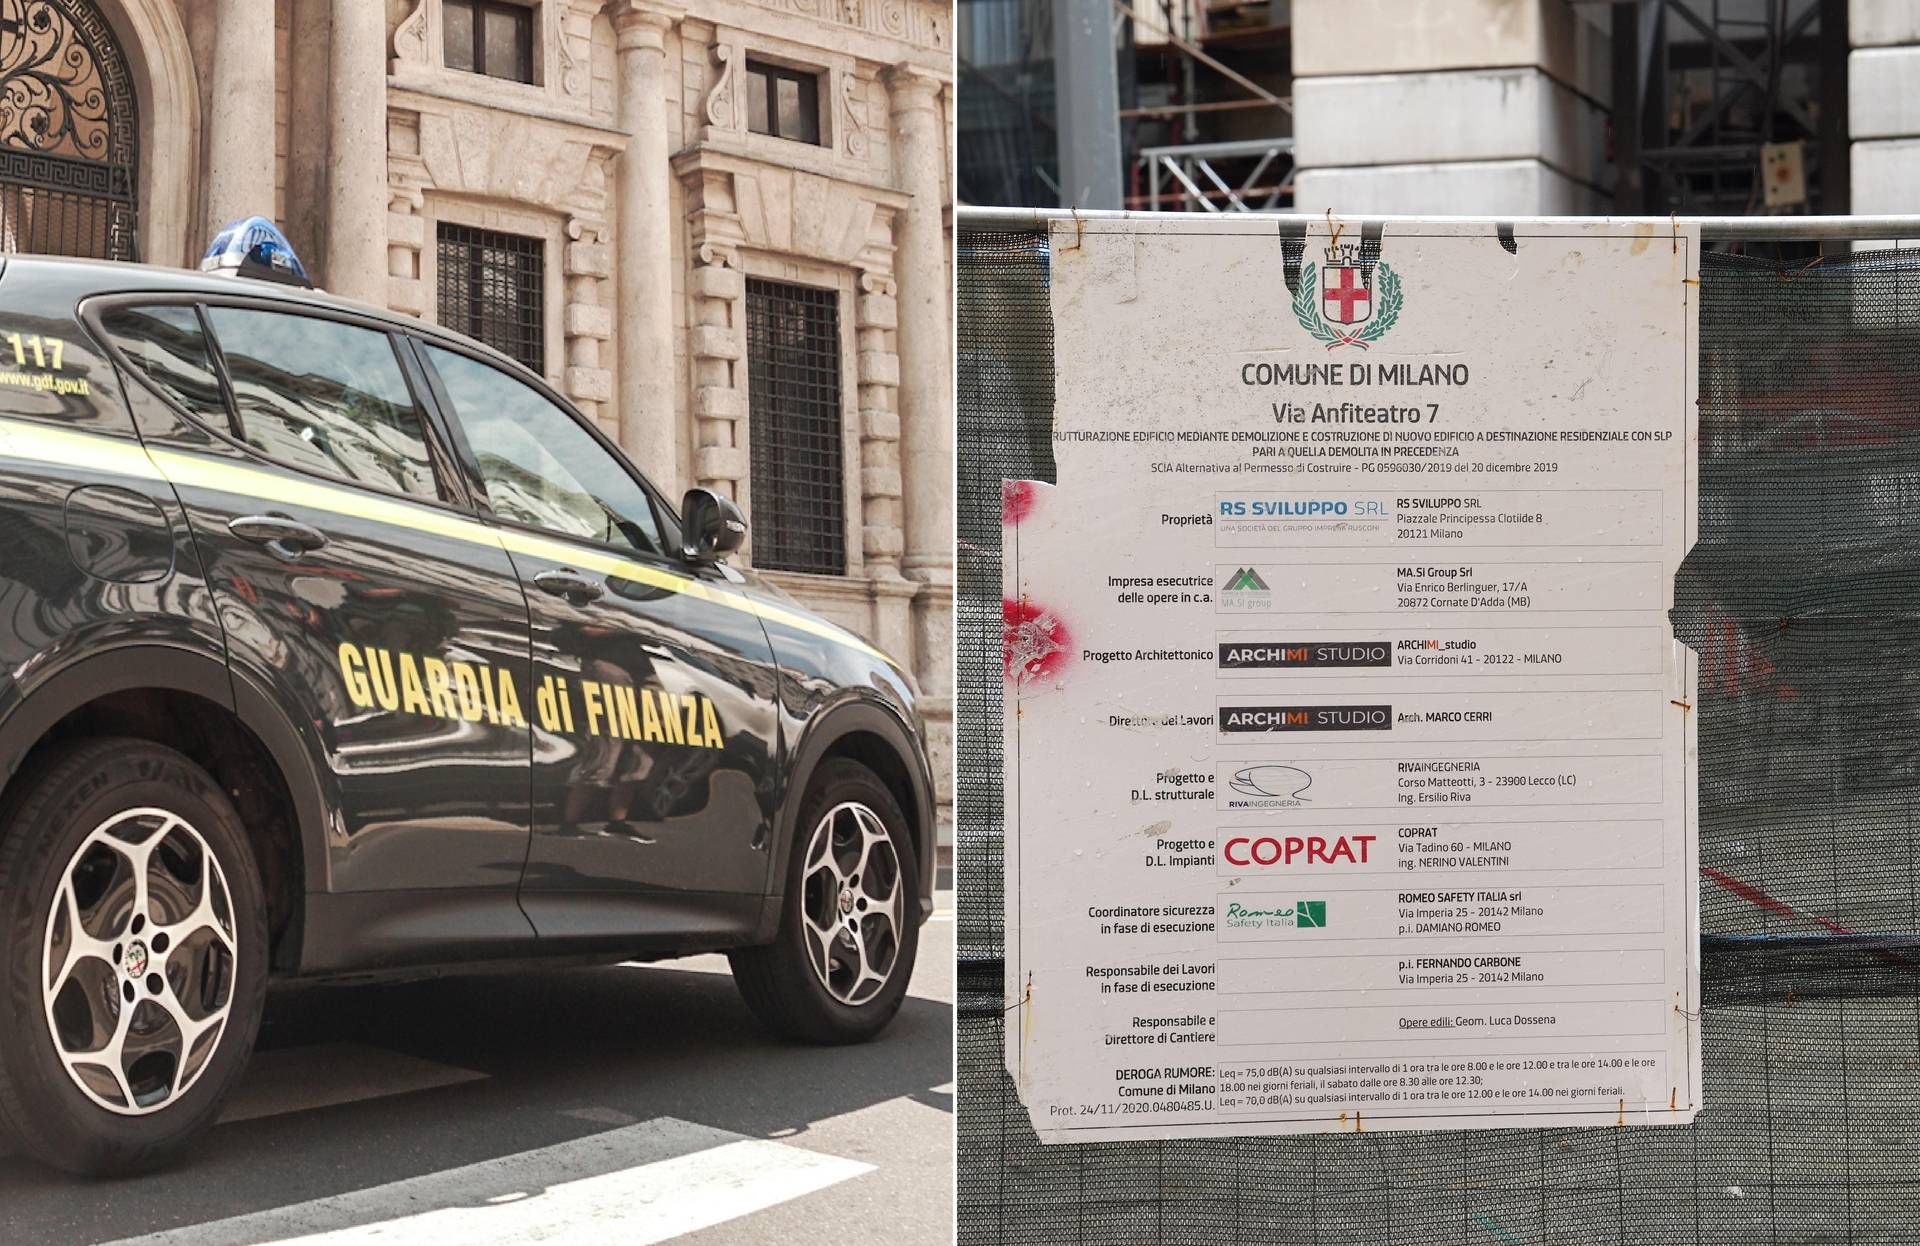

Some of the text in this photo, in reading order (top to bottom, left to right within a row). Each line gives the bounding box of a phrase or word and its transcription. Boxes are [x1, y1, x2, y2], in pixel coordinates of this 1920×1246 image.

[7, 333, 63, 370] 117
[1241, 362, 1469, 386] COMUNE DI MILANO
[1271, 401, 1439, 423] Via Anfiteatro 7
[1132, 431, 1175, 442] EDIFICIO
[1176, 430, 1229, 442] MEDIANTE
[1230, 430, 1301, 442] DEMOLIZIONE
[1309, 430, 1381, 442] COSTRUZIONE
[1394, 431, 1432, 442] NUOVO
[1433, 431, 1475, 442] EDIFICIO
[1485, 430, 1558, 442] DESTINAZIONE
[1559, 430, 1629, 442] RESIDENZIALE
[1251, 445, 1276, 457] PARI
[1327, 445, 1379, 457] DEMOLITA
[1393, 445, 1459, 457] PRECEDENZA
[1150, 461, 1558, 473] SCIA Alternativa Permesso Costruire 0596030/2019 dicembre 2019
[1219, 500, 1389, 516] RS SVILUPPO SRL
[1411, 497, 1462, 509] SVILUPPO
[1161, 513, 1213, 527] Proprietà
[1396, 512, 1534, 525] Piazzale Principessa Clotilde
[1397, 527, 1463, 539] 20121 Milano
[1426, 566, 1458, 579] Group
[1107, 575, 1213, 589] Impresa esecutrice
[1414, 581, 1527, 595] Enrico Berlinguer, 17/A
[1117, 591, 1145, 603] delle
[1145, 593, 1179, 605] opere
[1192, 593, 1213, 603] c.a.
[1397, 595, 1531, 608] 20872 Cornate D'Adda (MB)
[1396, 639, 1477, 651] ARCHIMI_studio
[1083, 648, 1213, 664] Progetto Architettonico
[1226, 646, 1385, 662] ARCHIMI STUDIO
[1414, 653, 1562, 665] Corridoni 20122 MILANO
[338, 641, 724, 750] GUARDIA di FINANZA
[1178, 714, 1214, 726] Lavori
[1227, 710, 1385, 725] ARCHIMI STUDIO
[1396, 711, 1492, 723] Arch. MARCO CERRI
[1397, 761, 1481, 773] RIVAINGEGNERIA
[1155, 772, 1206, 787] Progetto
[1397, 773, 1577, 788] Corso Matteotti, 23900 Lecco (LC)
[1130, 788, 1215, 801] D.L. strutturale
[1397, 791, 1471, 805] Ing. Ersilio Riva
[1228, 799, 1301, 808] RIVAINGEGNERIA
[1397, 826, 1438, 838] COPRAT
[1156, 837, 1206, 853] Progetto
[1223, 835, 1377, 866] COPRAT
[1415, 840, 1512, 853] Tadino MILANO
[1145, 854, 1215, 869] D.L. Impianti
[1397, 856, 1509, 871] ing. NERINO VALENTINI
[1397, 890, 1508, 904] ROMEO SAFETY ITALIA
[1087, 904, 1215, 918] Coordinatore sicurezza
[1226, 902, 1294, 919] Romeo
[1415, 905, 1544, 920] Imperia 20142 Milano
[1112, 921, 1215, 934] fase esecuzione
[1225, 916, 1296, 929] Safety Italia
[1397, 921, 1501, 936] p.i. DAMIANO ROMEO
[1085, 962, 1215, 979] Responsabile Lavori
[1397, 956, 1521, 972] p.i. FERNANDO CARBONE
[1415, 971, 1544, 986] Imperia 20142 Milano
[1113, 979, 1216, 993] fase esecuzione
[1131, 1014, 1207, 1030] Responsabile
[1398, 1014, 1556, 1030] Opere edili: Geom. Luca Dossena
[1104, 1031, 1216, 1045] Direttore Cantiere
[1115, 1066, 1215, 1080] DEROGA RUMORE:
[1265, 1058, 1623, 1078] dB(A) qualsiasi intervallo 12.00 14.00
[1117, 1082, 1216, 1097] Comune Milano
[1219, 1075, 1483, 1093] 18.00 giorni feriali, sabato dalle 12.30;
[1049, 1100, 1215, 1116] Prot. 24/11/2020.0480485.U.
